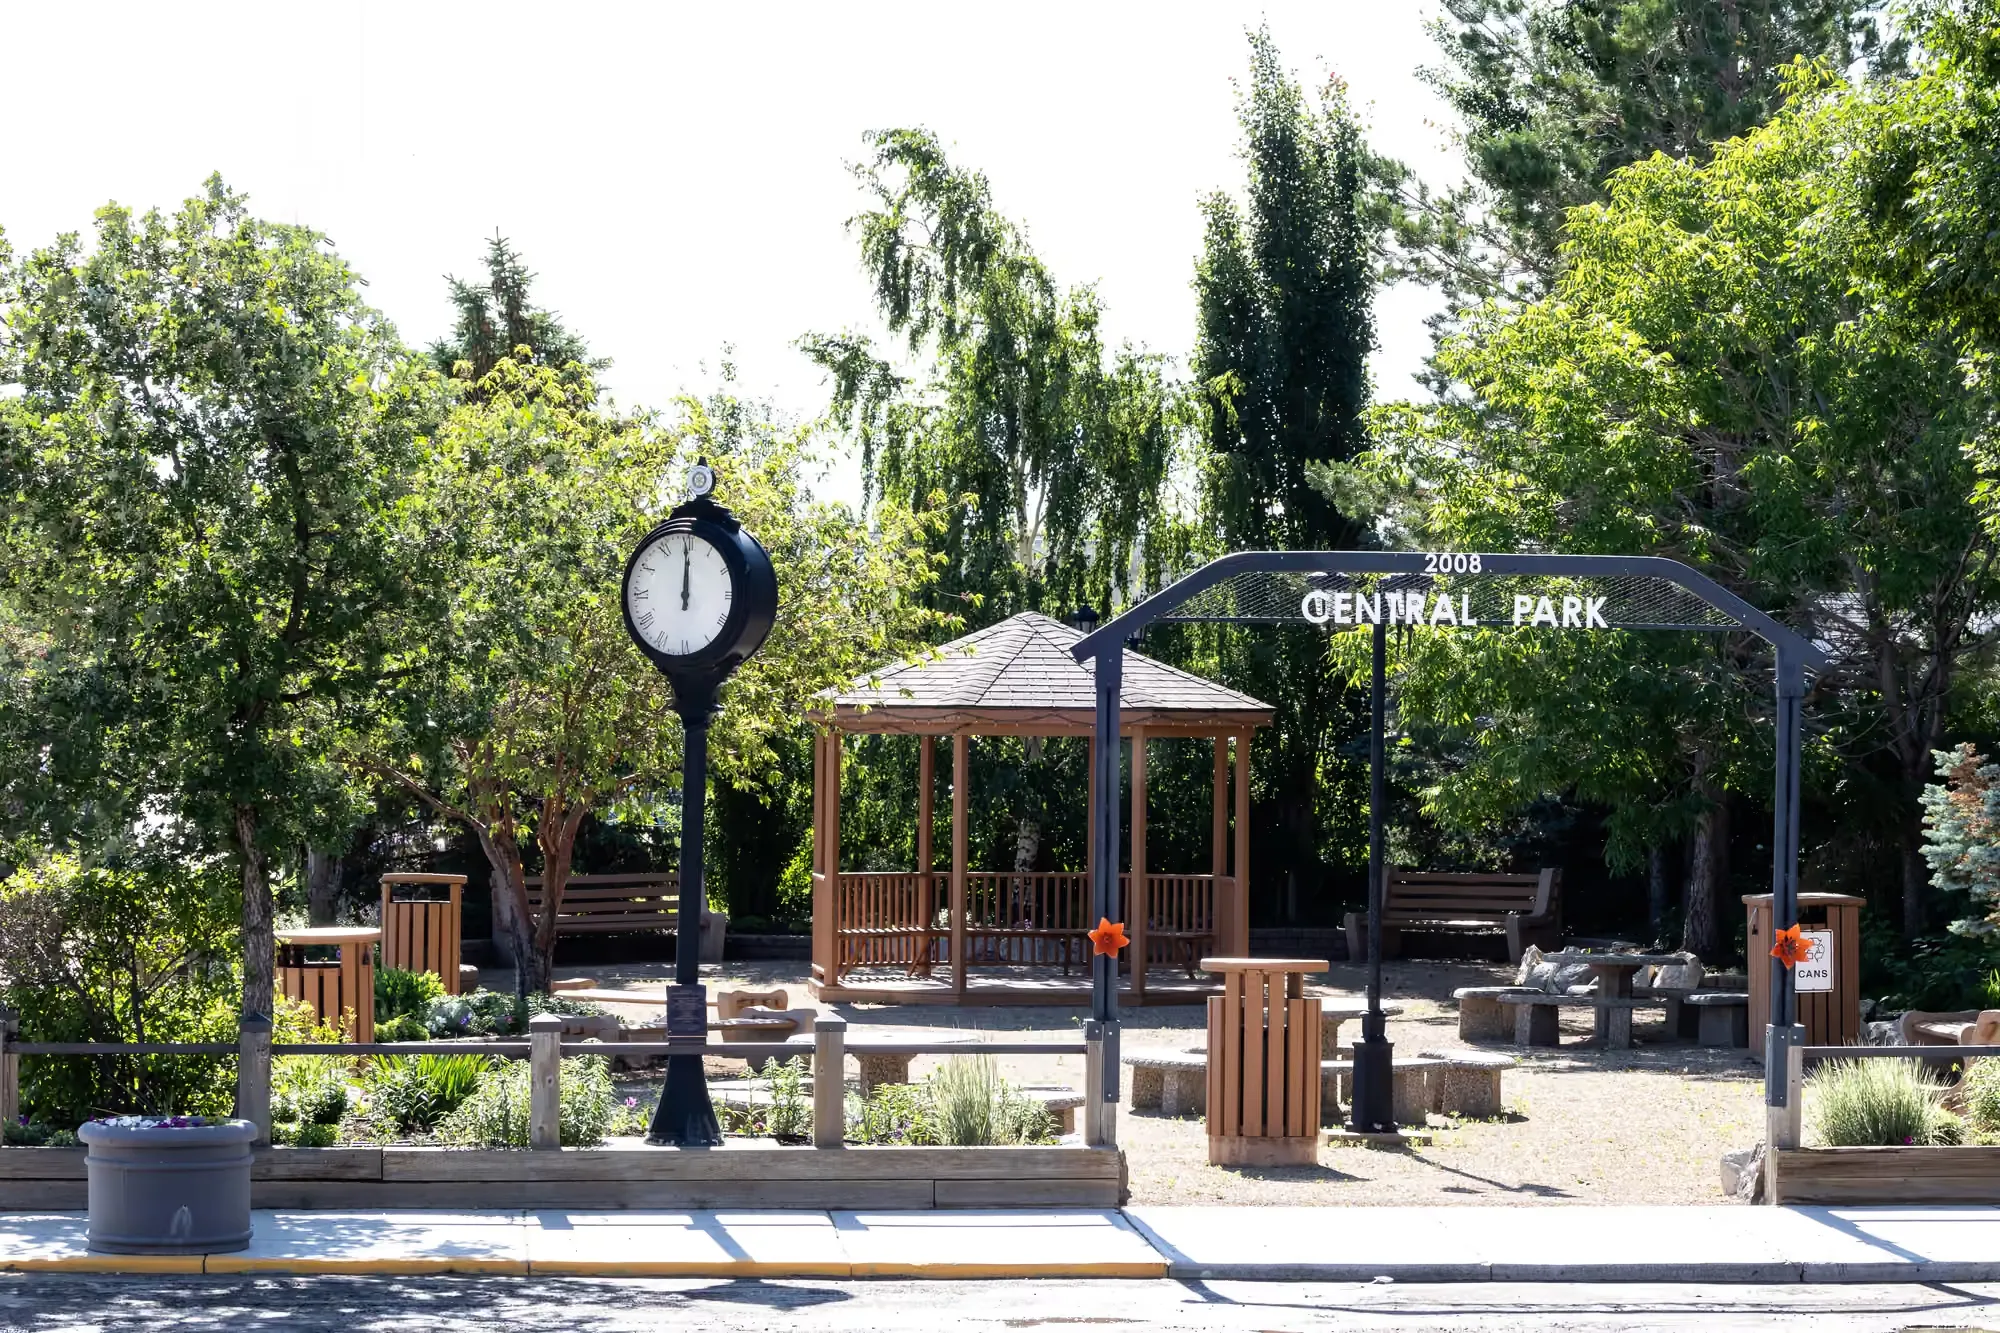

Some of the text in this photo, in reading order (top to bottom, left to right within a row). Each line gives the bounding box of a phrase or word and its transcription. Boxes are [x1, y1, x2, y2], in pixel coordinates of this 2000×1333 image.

[1424, 553, 1482, 573] 2008
[1301, 591, 1609, 628] CENTRAL PARK
[1798, 969, 1828, 978] CANS
